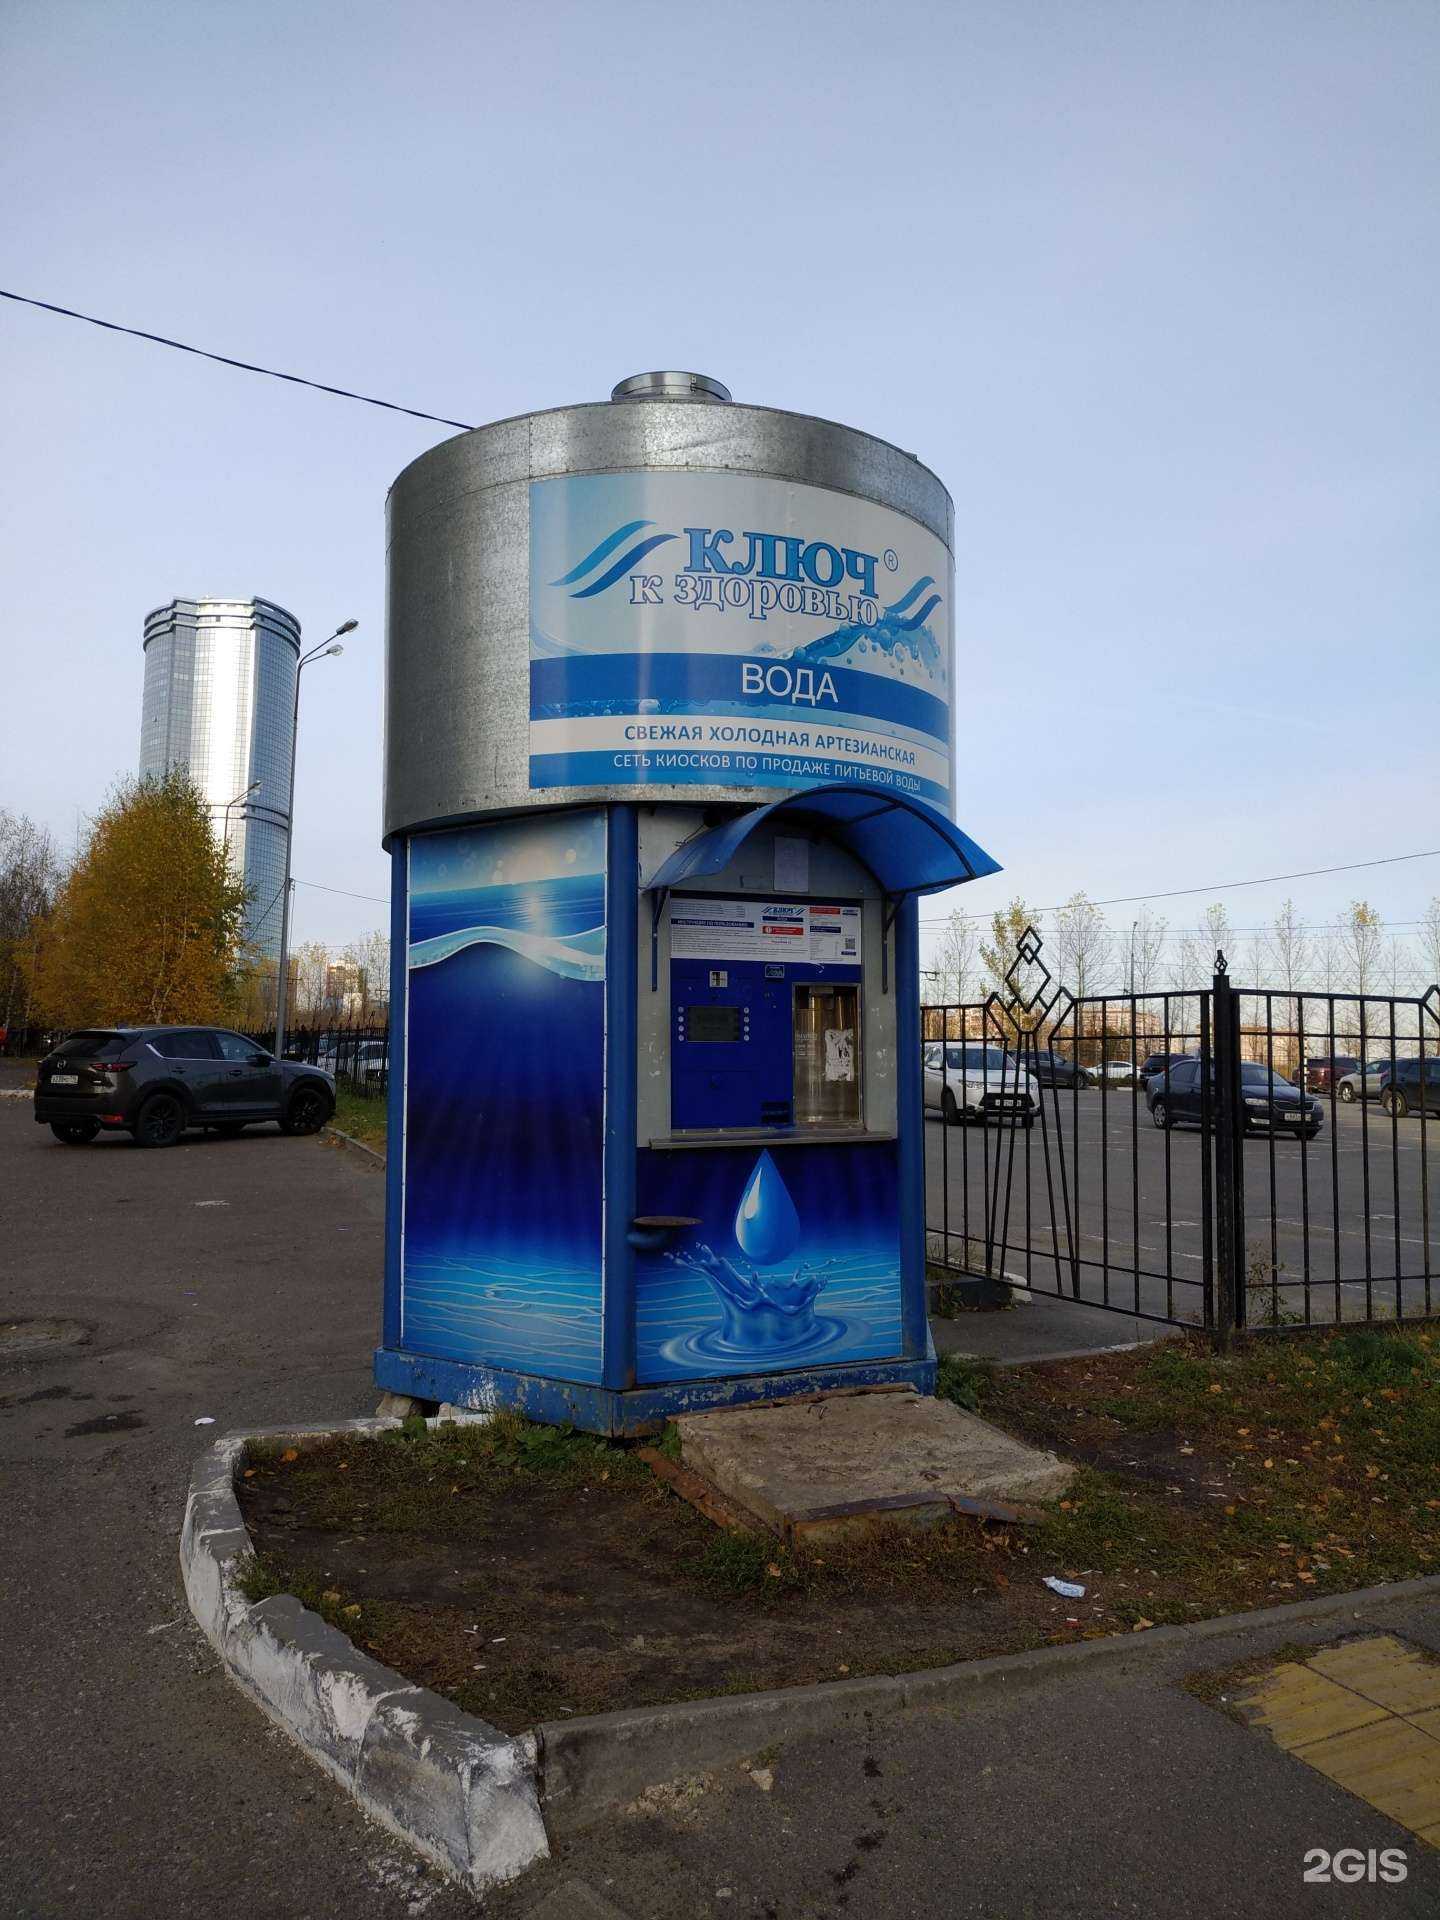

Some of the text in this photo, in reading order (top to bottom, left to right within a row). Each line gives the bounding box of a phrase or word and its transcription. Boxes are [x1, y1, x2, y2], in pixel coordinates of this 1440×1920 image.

[683, 528, 879, 599] КЛЮЧ
[742, 663, 839, 707] ВОДА
[624, 725, 916, 766] СВЕЖАЯ ХОЛОДНАЯ АРТЕЗИАНСКАЯ
[613, 754, 921, 792] СЕТЬ КИОСКОВ ПО ПРОДАЖЕ ПИТЬЕВОЙ ВОДЫ
